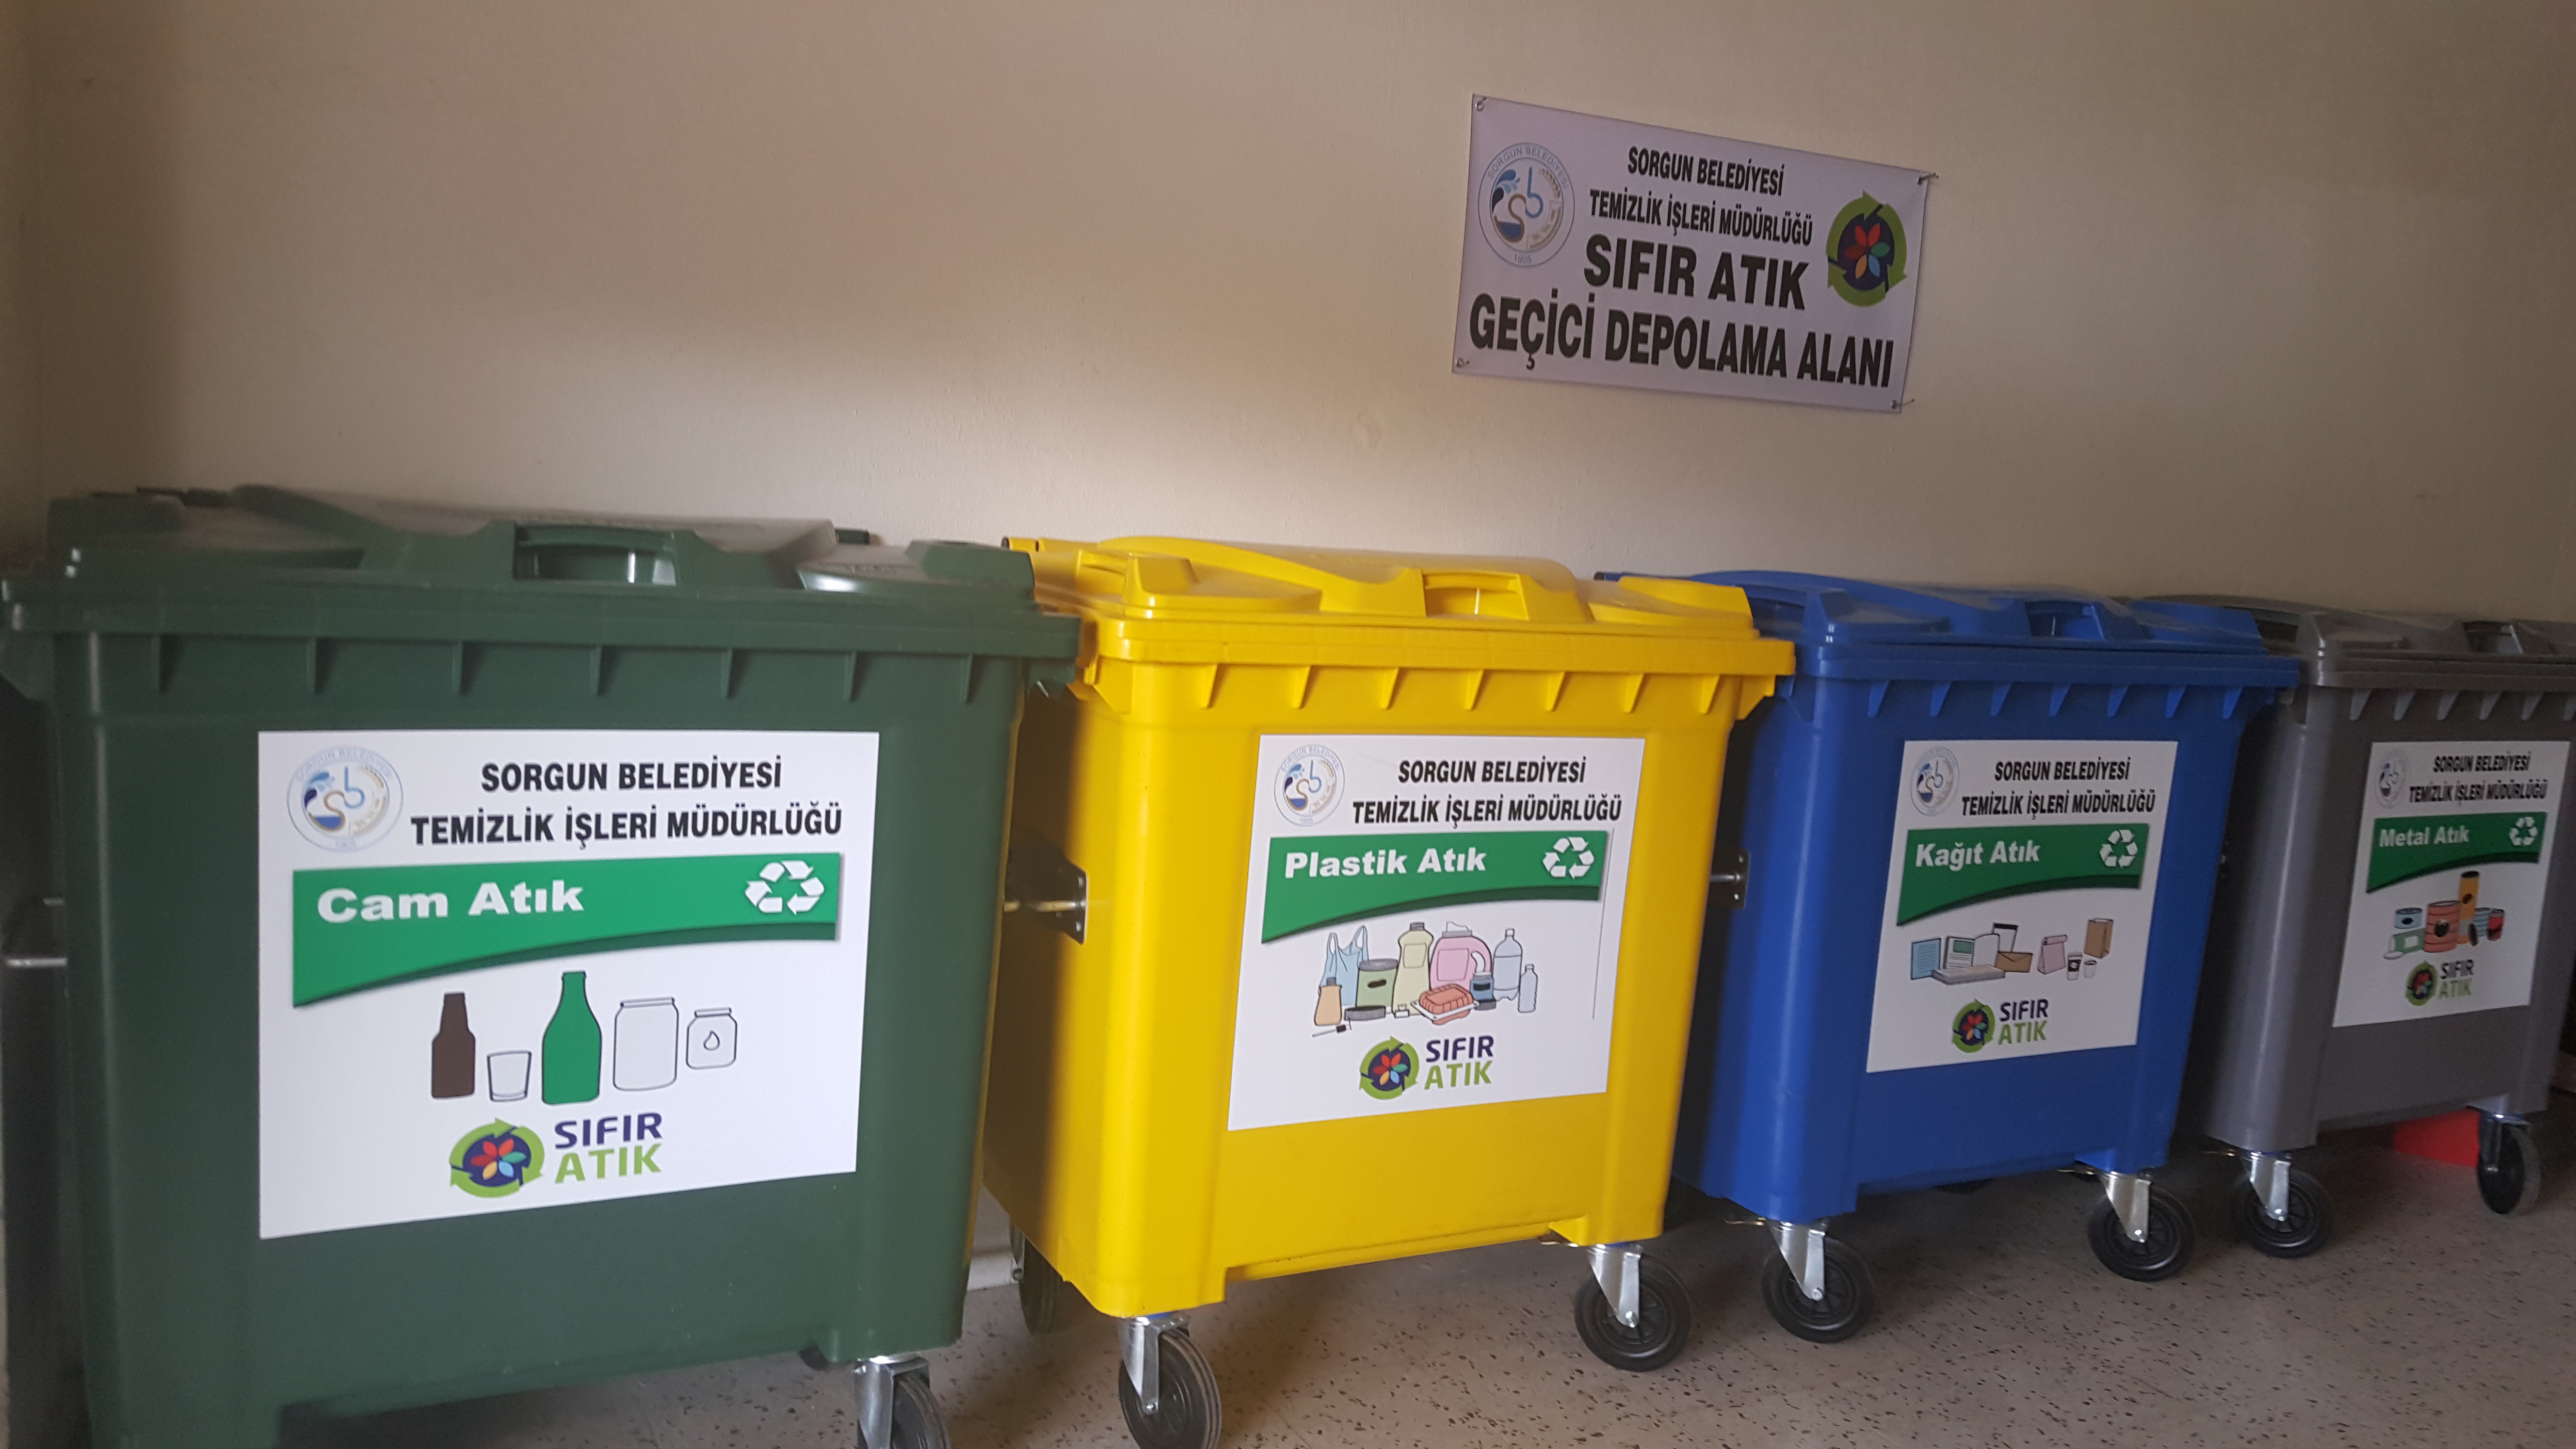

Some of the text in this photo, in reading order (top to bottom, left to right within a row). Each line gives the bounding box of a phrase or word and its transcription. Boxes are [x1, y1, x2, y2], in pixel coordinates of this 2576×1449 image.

[1488, 147, 1522, 178] SORGUN
[1628, 146, 1785, 196] SORGUN BELEDİYESİ
[1590, 187, 1812, 246] TEMİZLİK İŞLERİ MÜDÜRLÜĞÜ
[1584, 234, 1809, 310] SIFIR ATIK
[1470, 288, 1893, 387] GEÇİCİ DEPOLAMA ALANI
[482, 756, 781, 792] SORGUN BELEDİYESİ
[1399, 756, 1586, 783] SORGUN BELEDİYESİ
[1995, 757, 2130, 781] SORGUN BELEDİYESİ
[1353, 794, 1622, 830] TEMİZLİK İŞLERİ MÜDÜRLÜĞÜ
[1962, 789, 2155, 820] TEMİZLİK İŞLERİ MÜDÜRLÜĞÜ
[411, 802, 841, 851] TEMİZLİK İŞLERİ MÜDÜRLÜĞÜ
[2379, 825, 2469, 847] Metal Atık
[1286, 848, 1486, 878] Plastik Atık
[1916, 840, 2040, 871] Kağıt Atık
[318, 880, 583, 923] Cam Atık
[2440, 959, 2474, 979] SIFIR
[2439, 979, 2471, 998] ATIK
[2000, 999, 2048, 1022] SIFIR
[1998, 1020, 2046, 1045] ATIK
[1426, 1036, 1494, 1062] SIFIR
[1425, 1061, 1492, 1090] ATIK
[555, 1113, 661, 1149] SIFIR
[555, 1143, 661, 1184] ATIK
